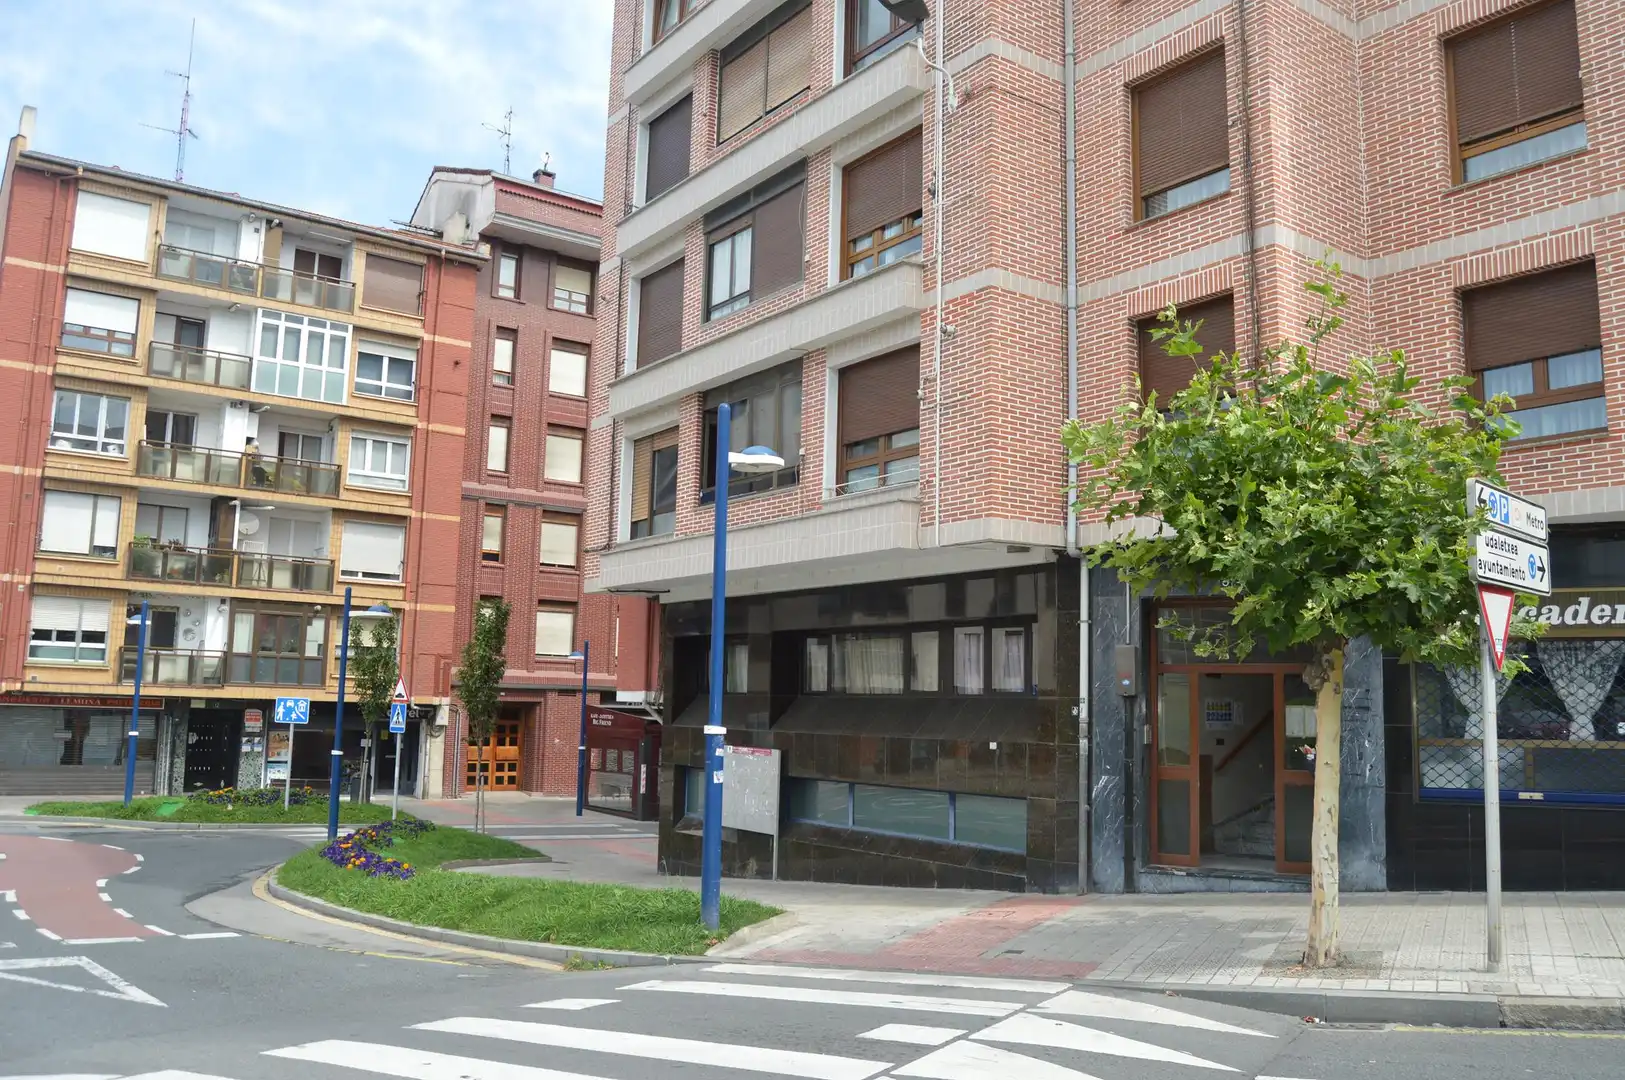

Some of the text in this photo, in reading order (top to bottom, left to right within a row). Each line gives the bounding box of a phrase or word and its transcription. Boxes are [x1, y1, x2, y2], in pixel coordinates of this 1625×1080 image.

[1501, 498, 1544, 530] P Metro
[1484, 535, 1518, 556] udaletxea
[1478, 558, 1525, 581] ayuntamiento
